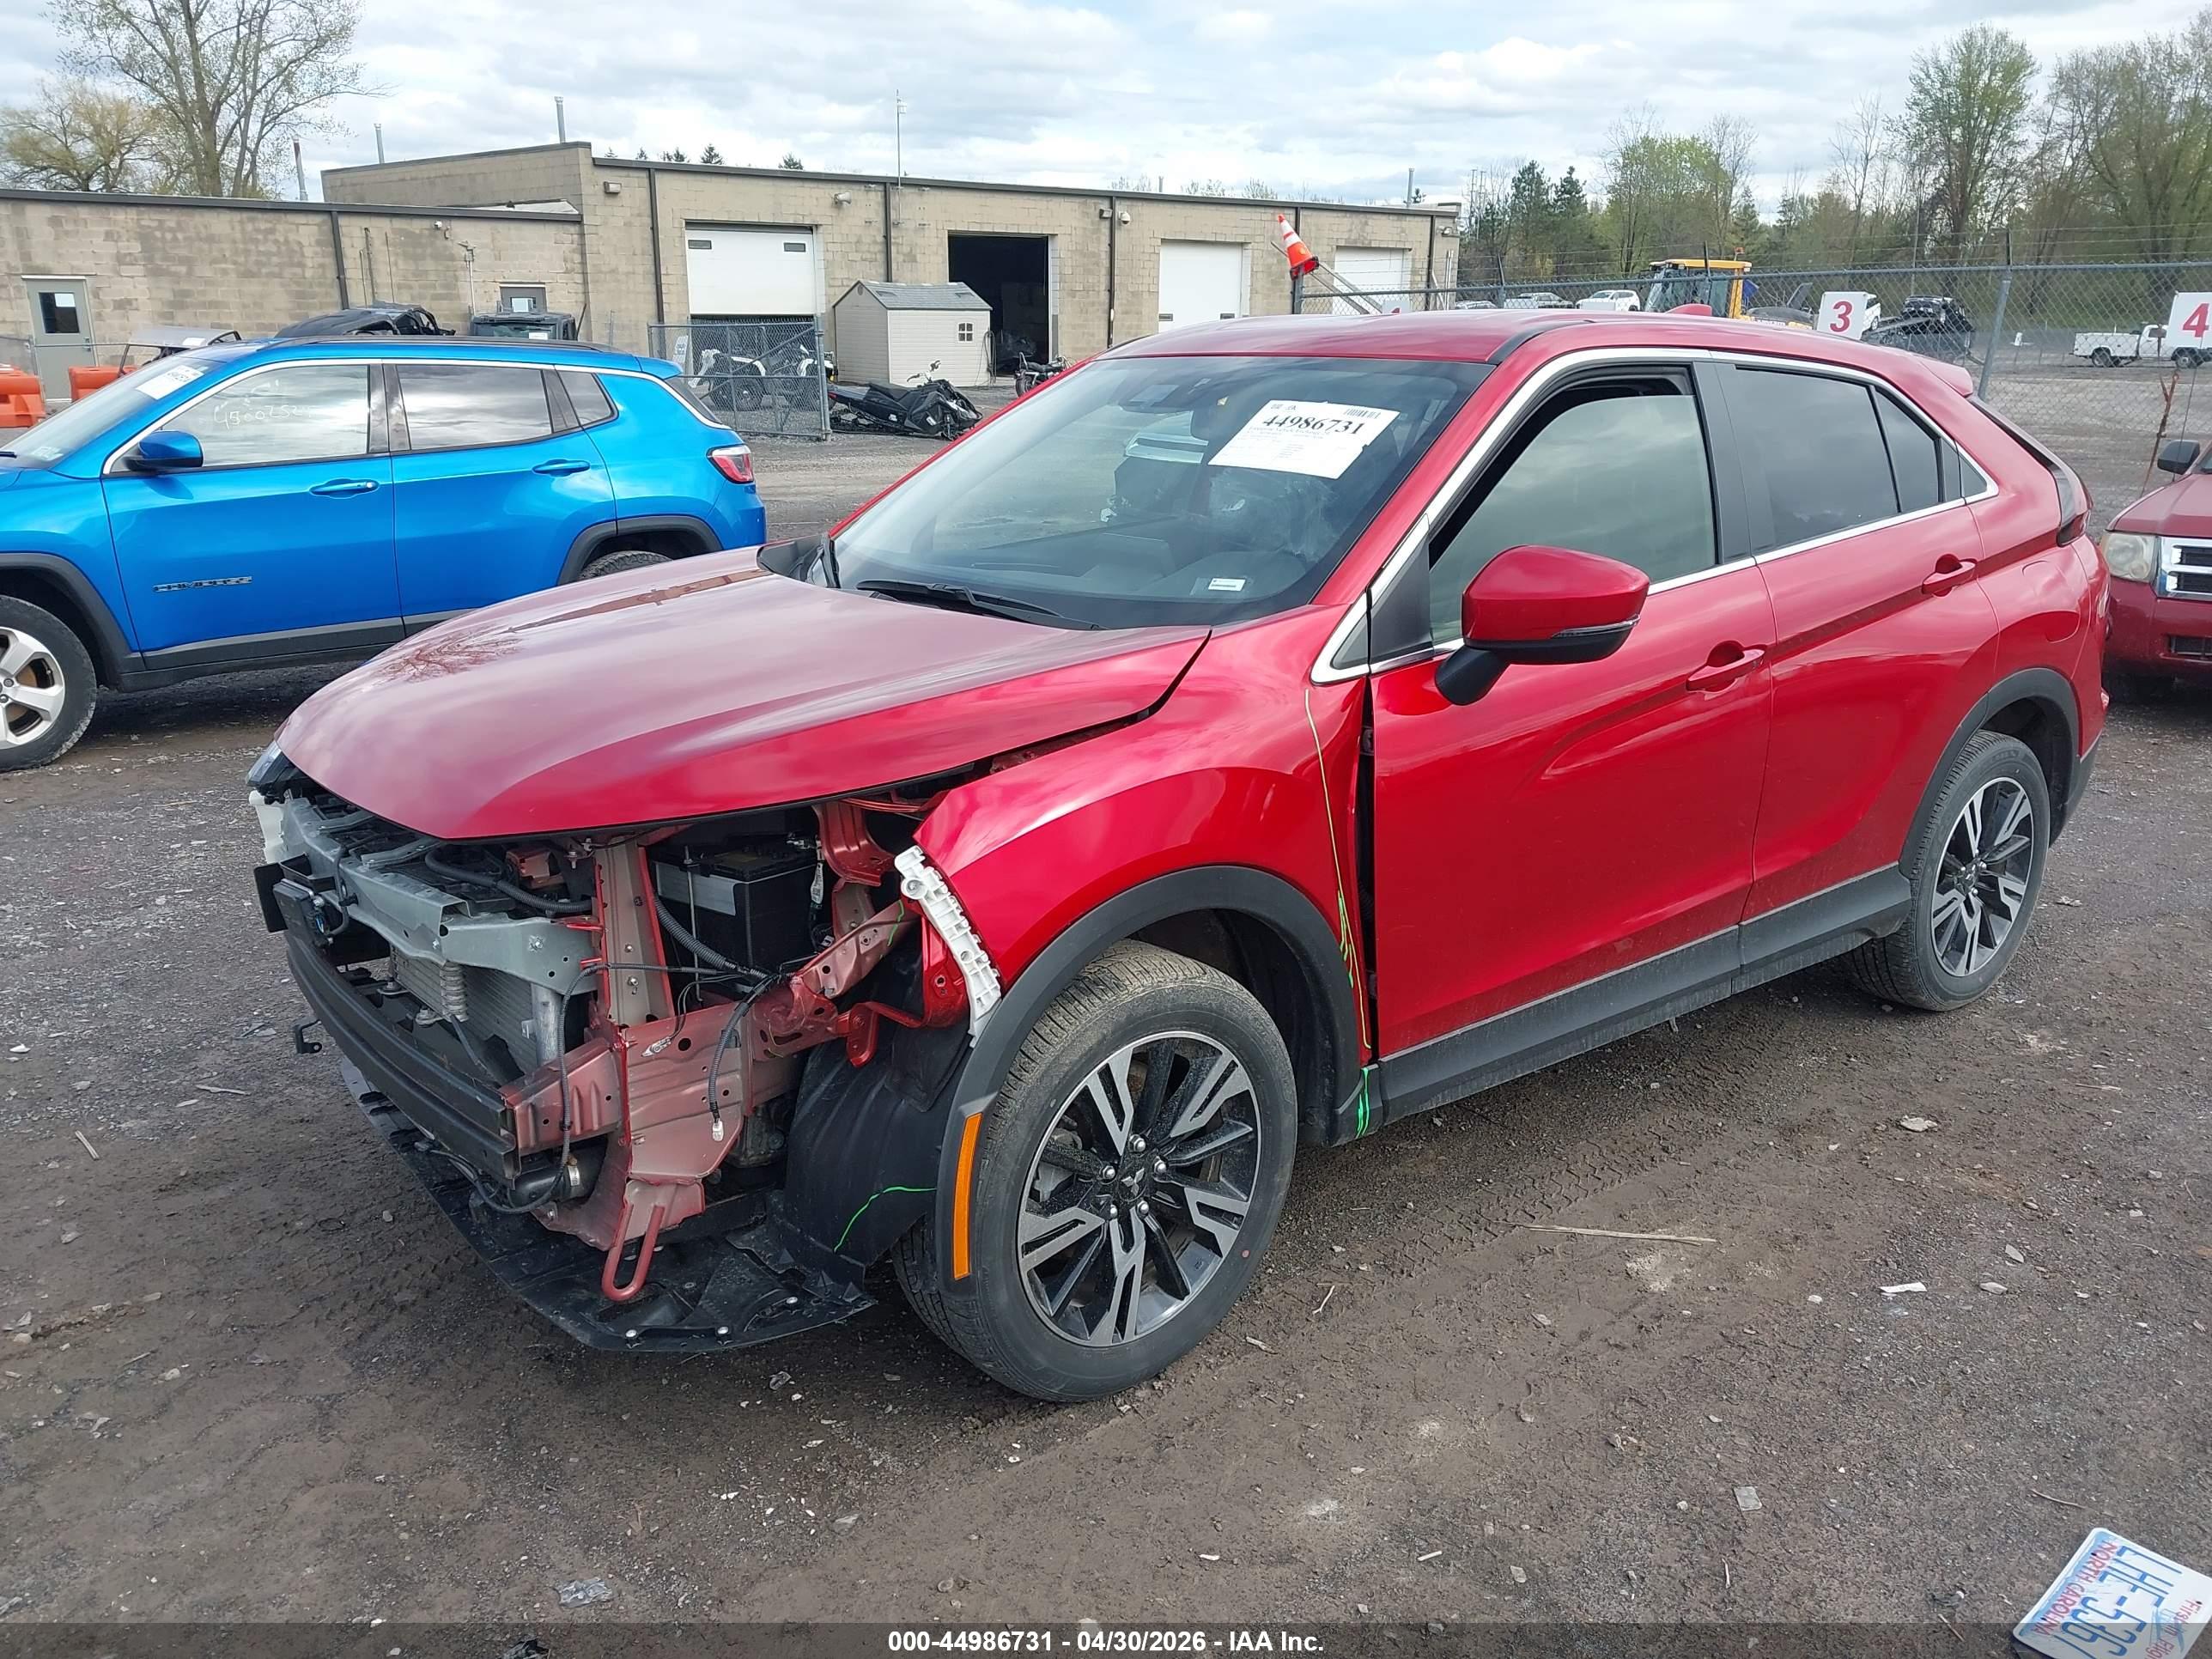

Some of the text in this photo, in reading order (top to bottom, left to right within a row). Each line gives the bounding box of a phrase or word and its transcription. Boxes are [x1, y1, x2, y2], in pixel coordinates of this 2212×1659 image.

[1830, 301, 1852, 332] 3
[2182, 303, 2209, 337] 4
[1262, 415, 1366, 434] 44986731
[2030, 1540, 2118, 1636] NORTH CAROLINA
